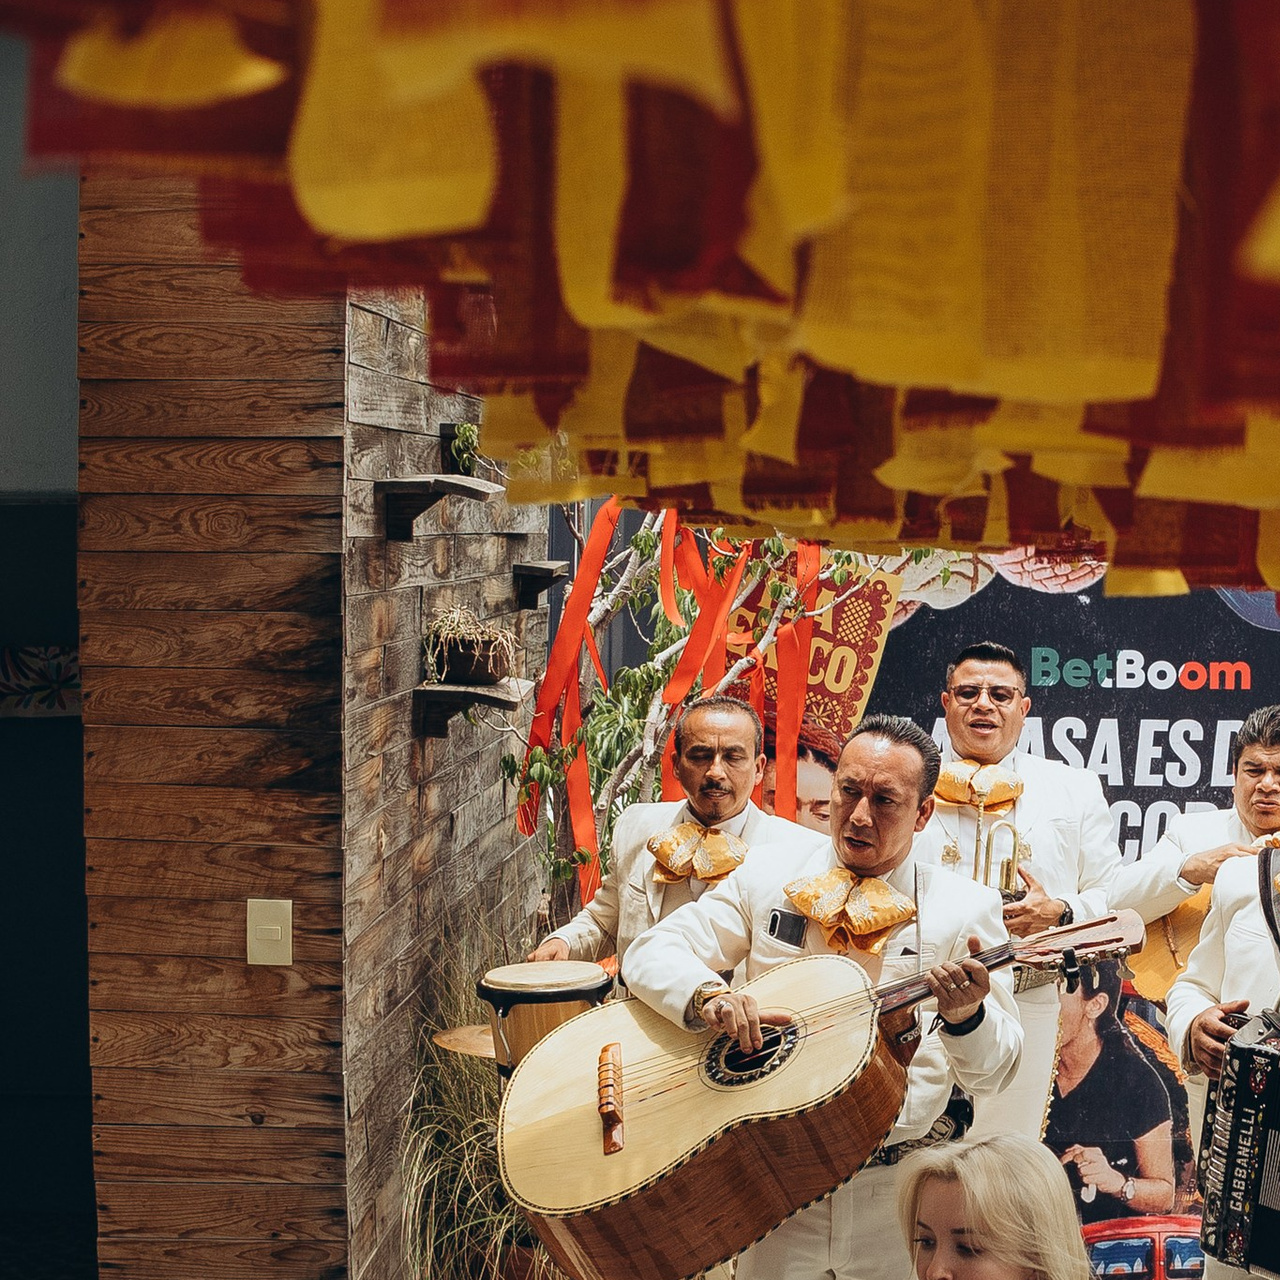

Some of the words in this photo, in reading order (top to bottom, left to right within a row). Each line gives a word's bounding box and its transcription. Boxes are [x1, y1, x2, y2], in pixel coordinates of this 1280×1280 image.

[1031, 646, 1252, 691] BetBoom
[1017, 716, 1124, 786] ASA
[1133, 718, 1204, 788] ES
[1229, 1107, 1256, 1212] GABBANELLI
